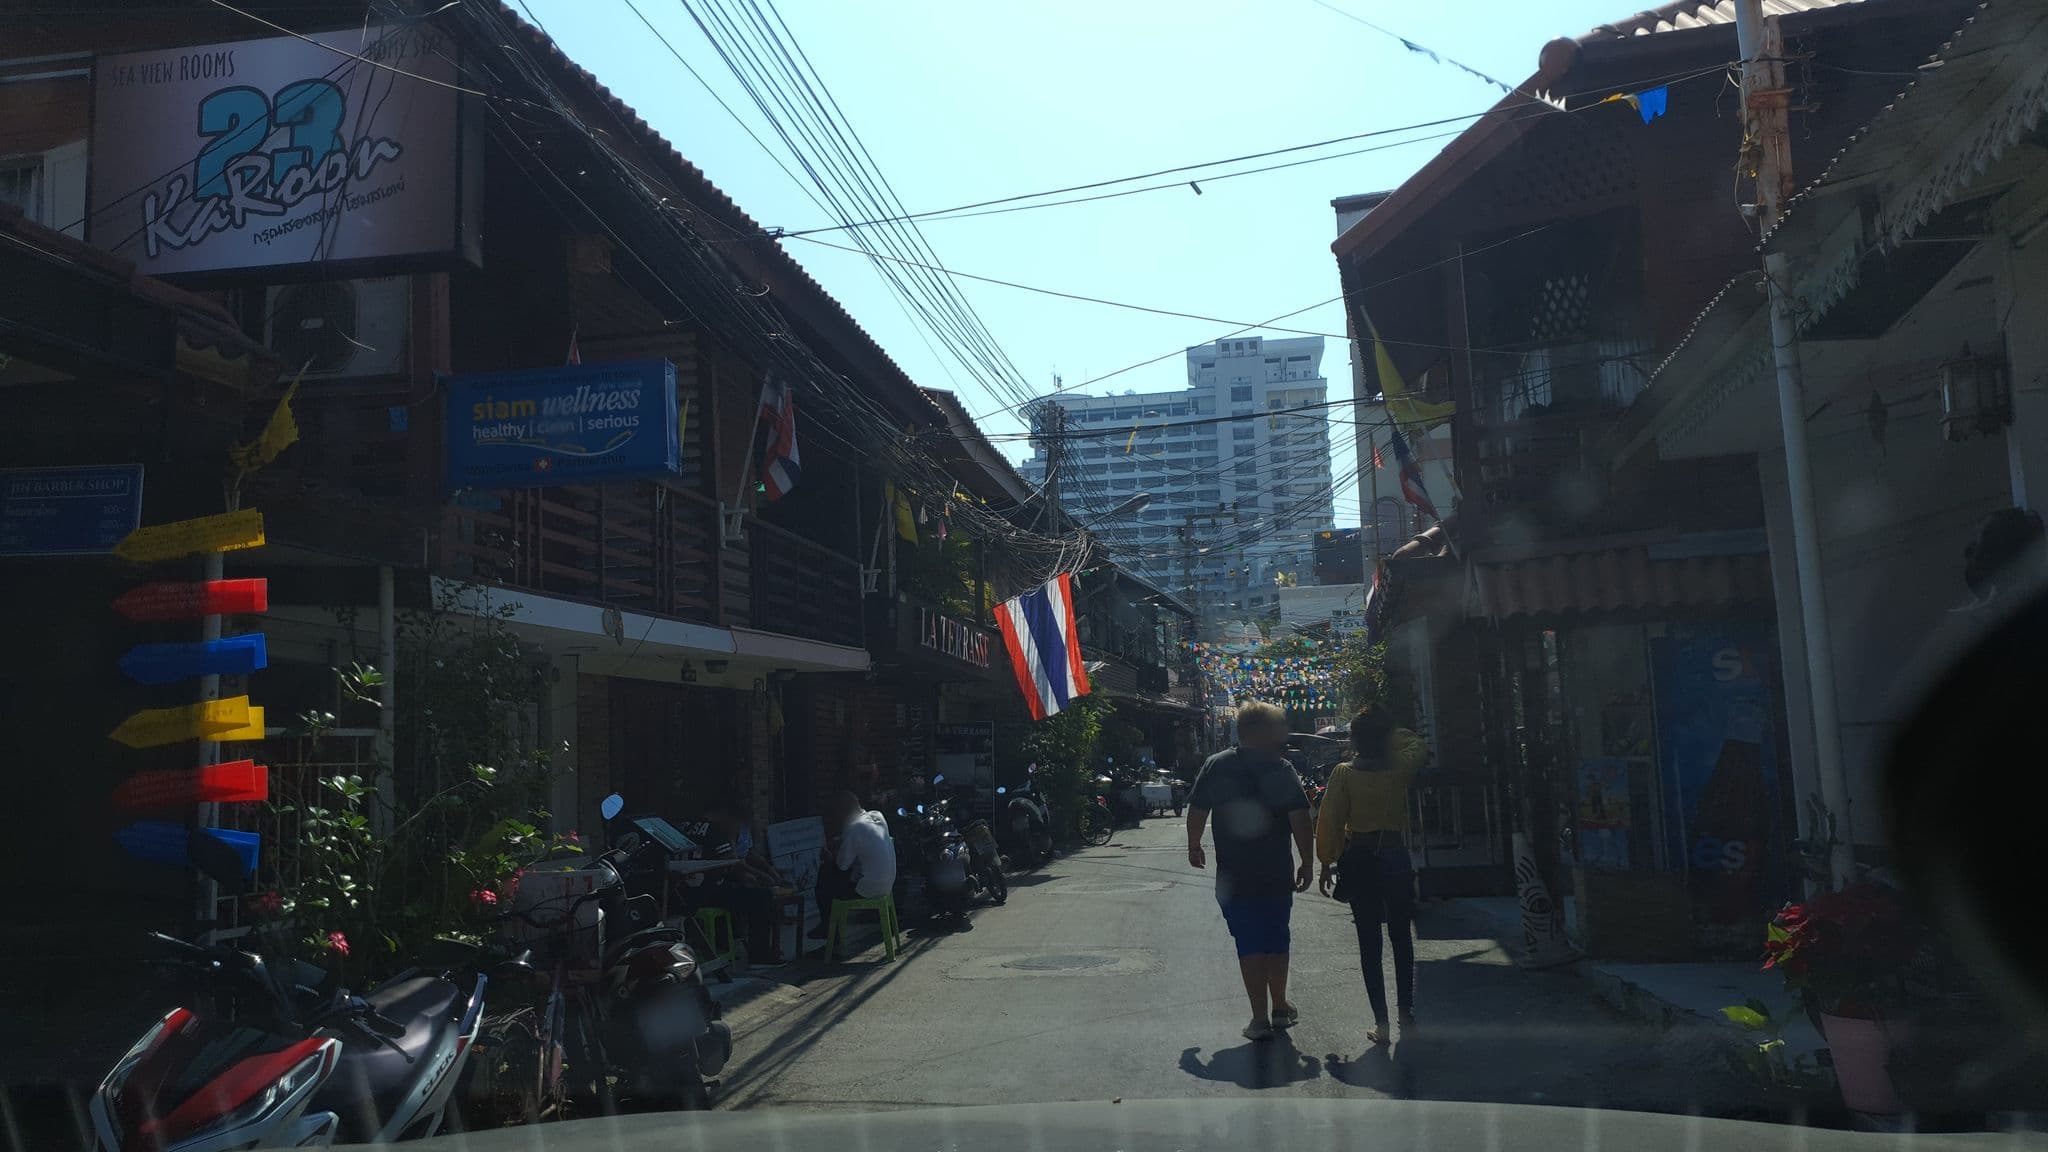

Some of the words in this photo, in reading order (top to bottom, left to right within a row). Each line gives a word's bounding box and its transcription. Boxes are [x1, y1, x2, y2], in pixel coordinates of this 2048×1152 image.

[112, 65, 135, 86] SEA
[141, 61, 174, 84] VIEW
[180, 50, 235, 80] ROOMS
[196, 80, 346, 200] 23
[472, 397, 537, 421] siam
[541, 385, 641, 417] wellness
[472, 421, 526, 440] healthy
[587, 414, 641, 432] serious
[86, 478, 126, 491] SHOP
[920, 607, 937, 650] LA
[939, 615, 990, 669] TERRASSE
